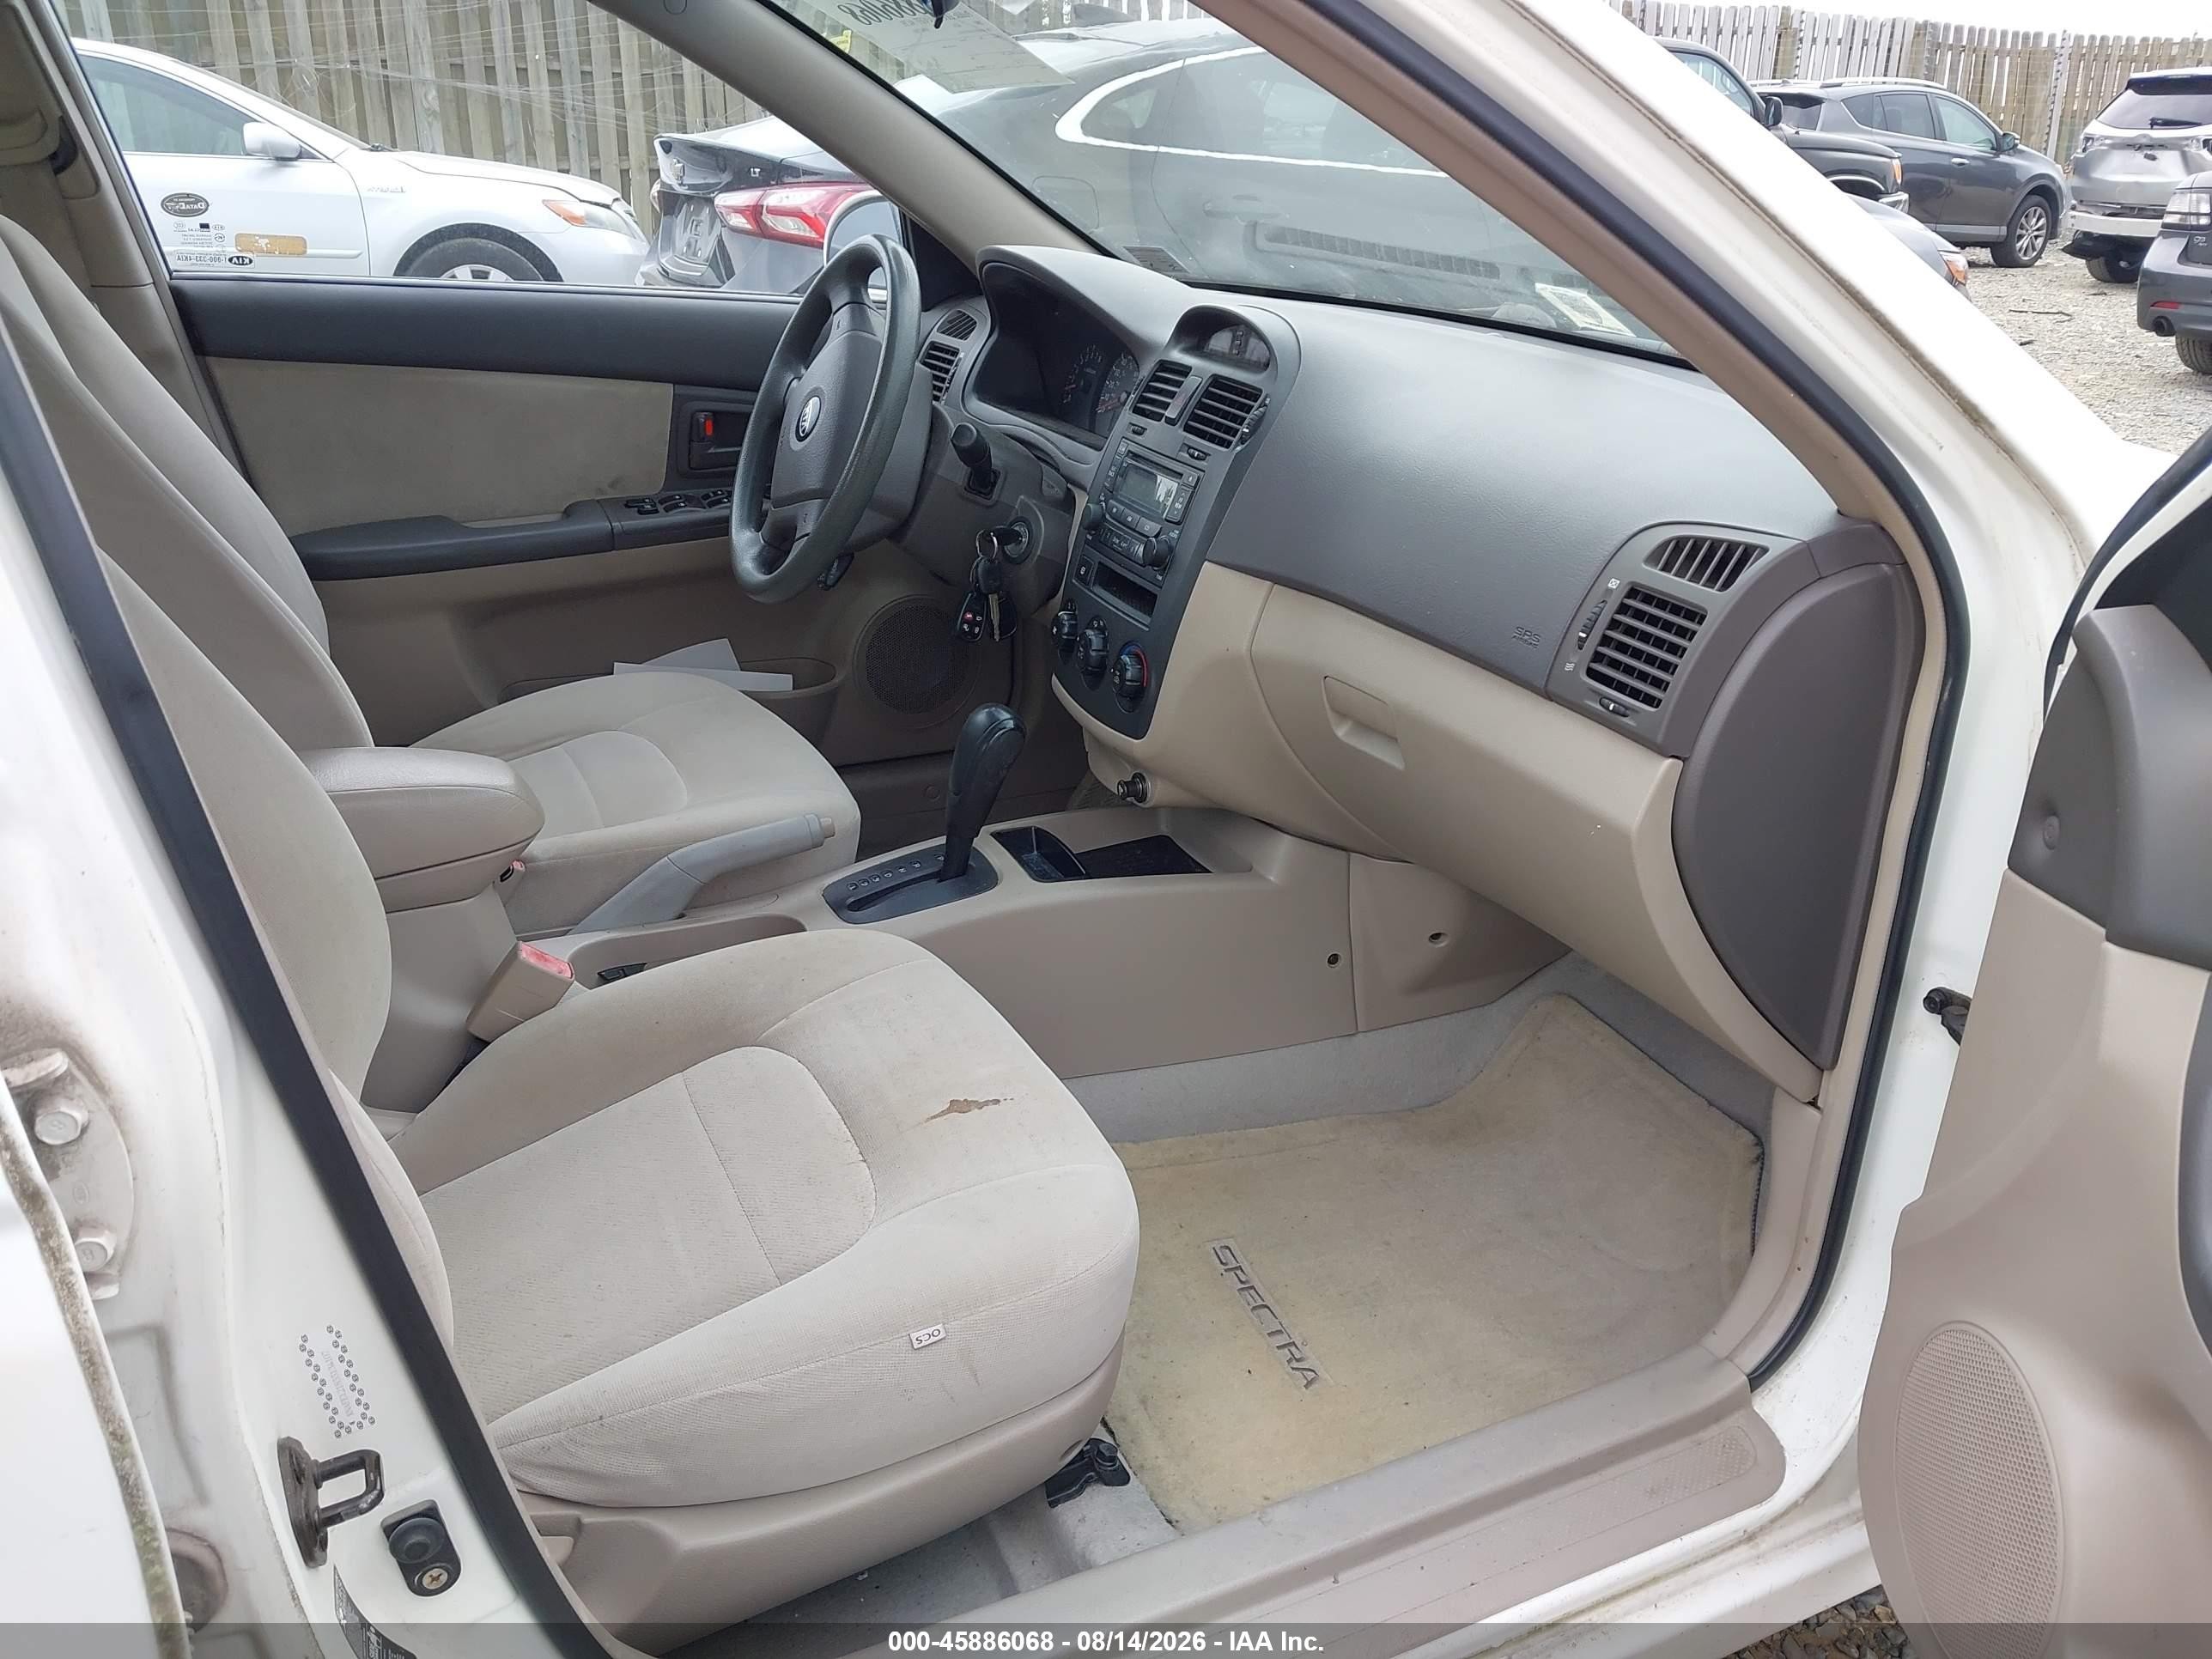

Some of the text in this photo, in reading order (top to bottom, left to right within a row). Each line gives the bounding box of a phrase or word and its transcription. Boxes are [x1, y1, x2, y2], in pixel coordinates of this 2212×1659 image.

[750, 167, 761, 177] LT
[1212, 1244, 1320, 1389] SPECTRA
[915, 1328, 941, 1345] OCS
